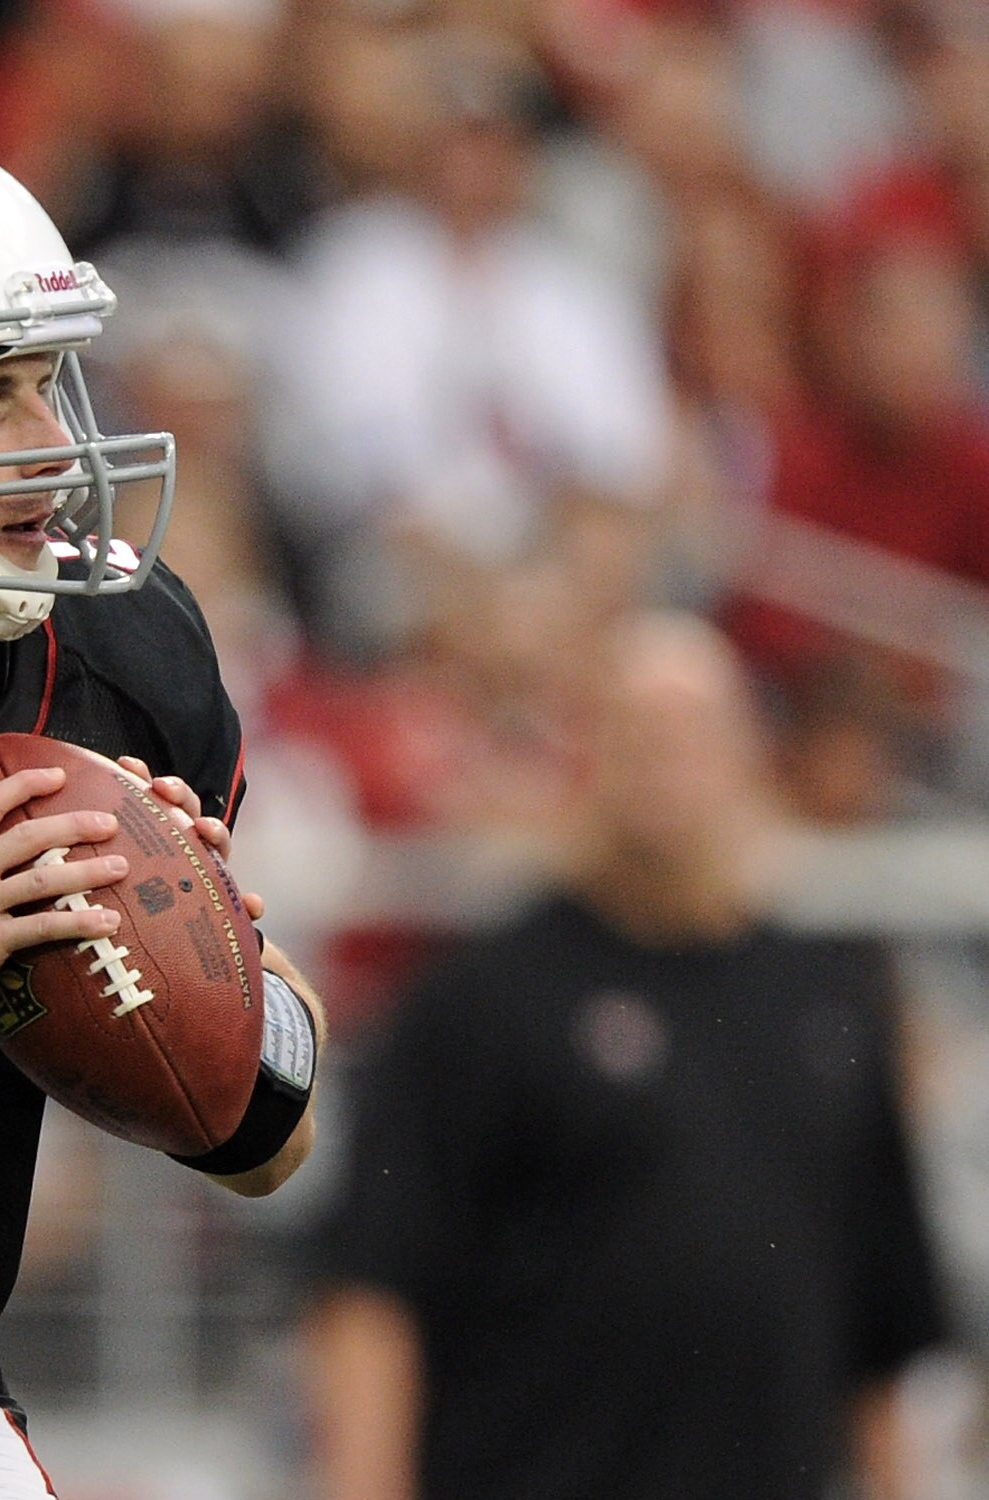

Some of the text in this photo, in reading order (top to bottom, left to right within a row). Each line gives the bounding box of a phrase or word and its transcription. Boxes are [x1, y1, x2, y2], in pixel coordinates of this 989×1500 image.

[34, 269, 82, 293] Riddel
[170, 826, 226, 913] FOOTBALL
[222, 917, 252, 1010] NATIONAL
